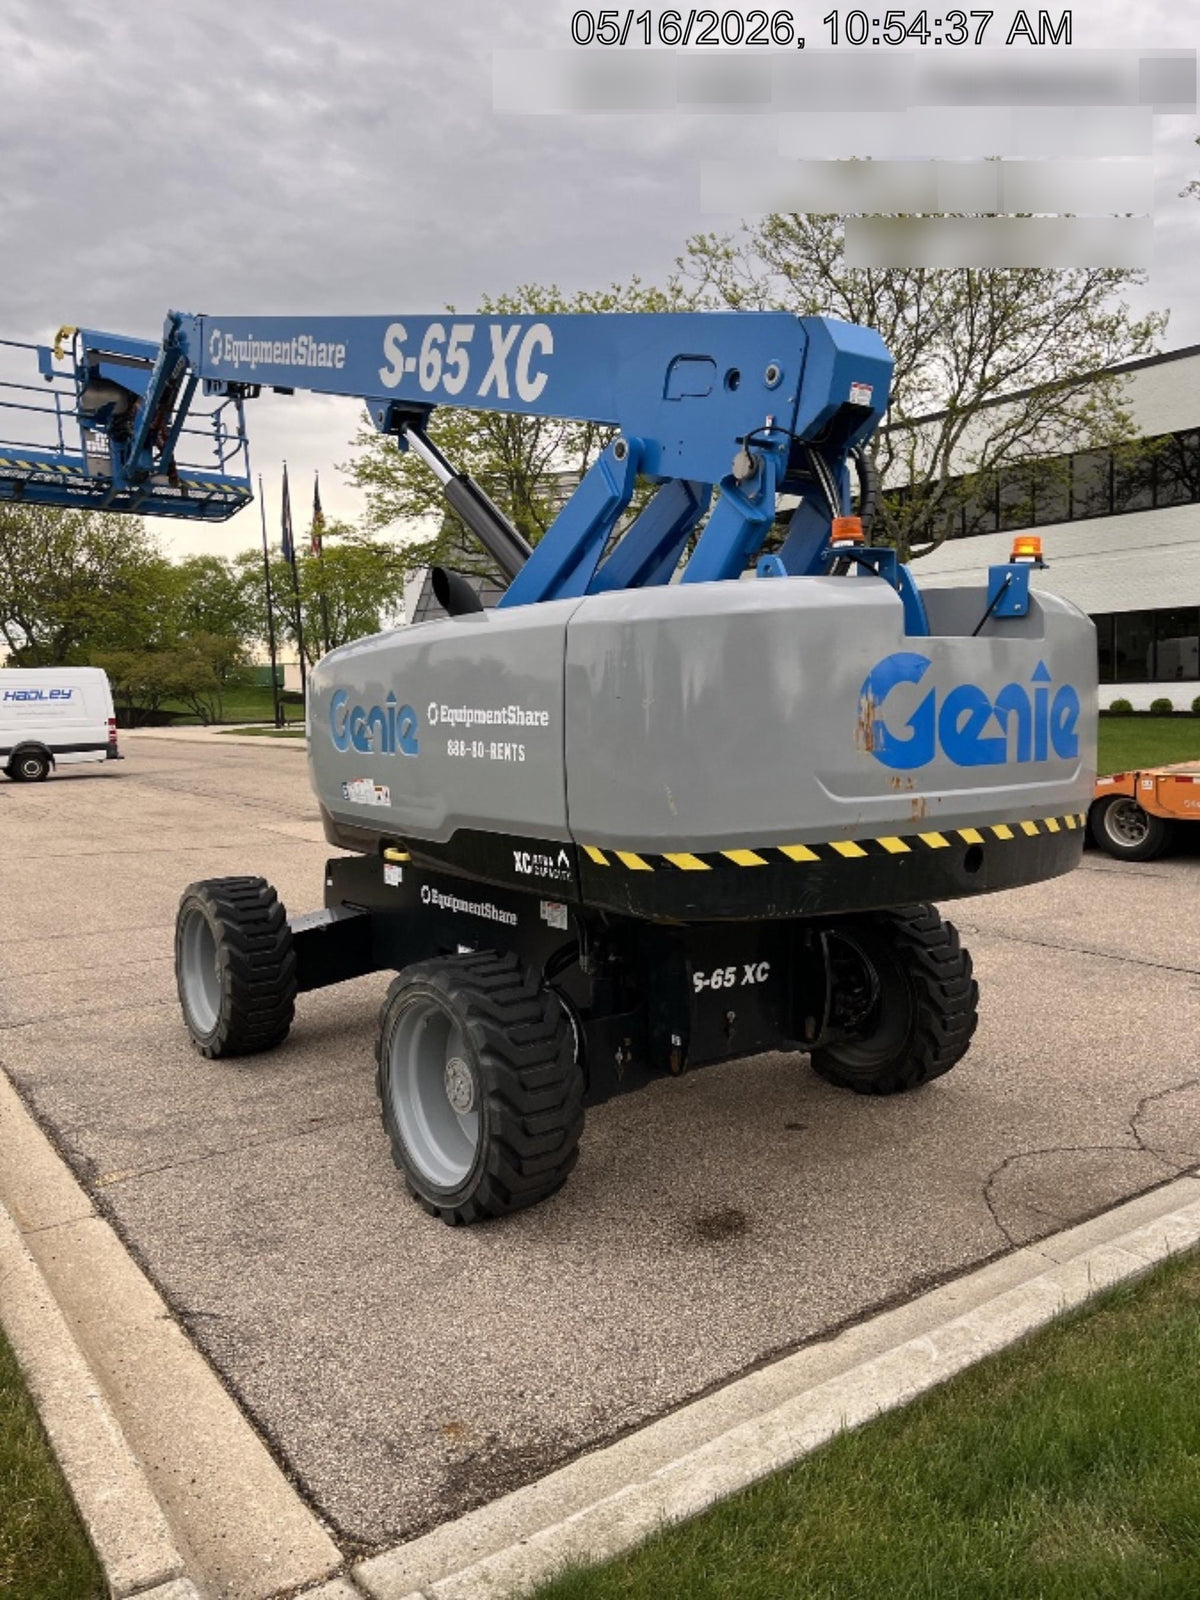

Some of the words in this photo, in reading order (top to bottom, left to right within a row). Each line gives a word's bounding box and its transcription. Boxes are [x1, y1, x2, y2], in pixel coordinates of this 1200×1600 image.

[223, 333, 346, 369] EquipmentShare
[378, 322, 475, 396] S-65
[477, 322, 554, 403] XC
[330, 688, 420, 756] Genie
[440, 705, 549, 728] EquipmentShare
[857, 652, 1080, 770] Genie
[431, 888, 518, 926] EquipmentShare
[692, 967, 737, 993] S-65
[741, 961, 771, 986] XC
